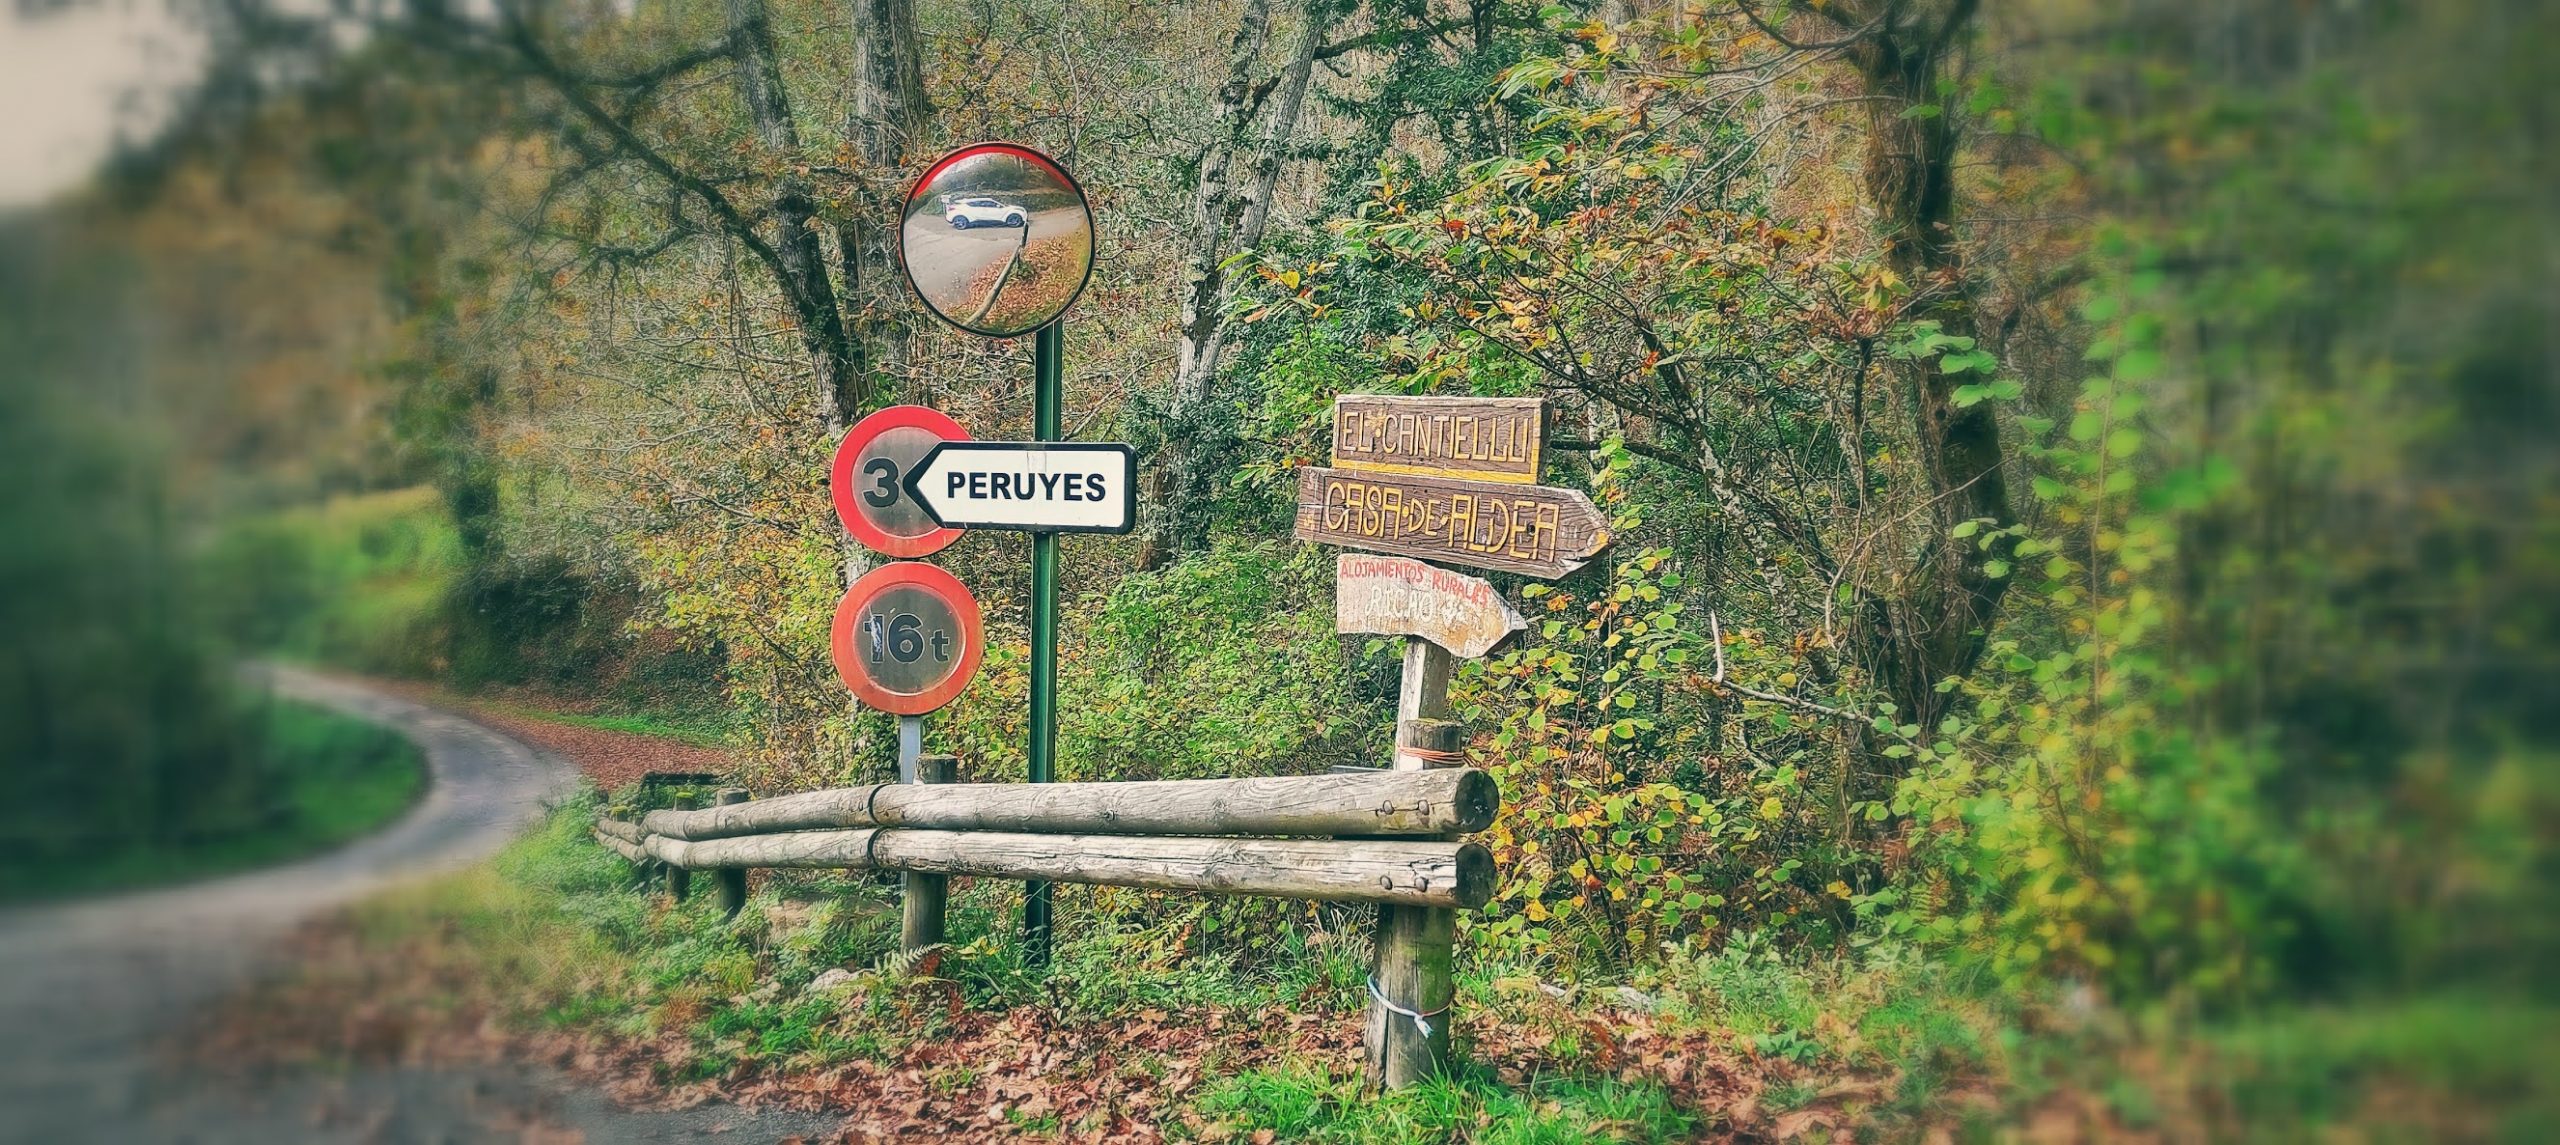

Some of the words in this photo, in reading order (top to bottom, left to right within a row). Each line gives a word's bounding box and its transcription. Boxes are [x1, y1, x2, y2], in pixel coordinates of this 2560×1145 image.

[862, 456, 901, 508] 3
[947, 471, 1106, 501] PERUYES
[1340, 559, 1425, 583] ALOJAMIENTOS
[1432, 572, 1490, 608] RURALES
